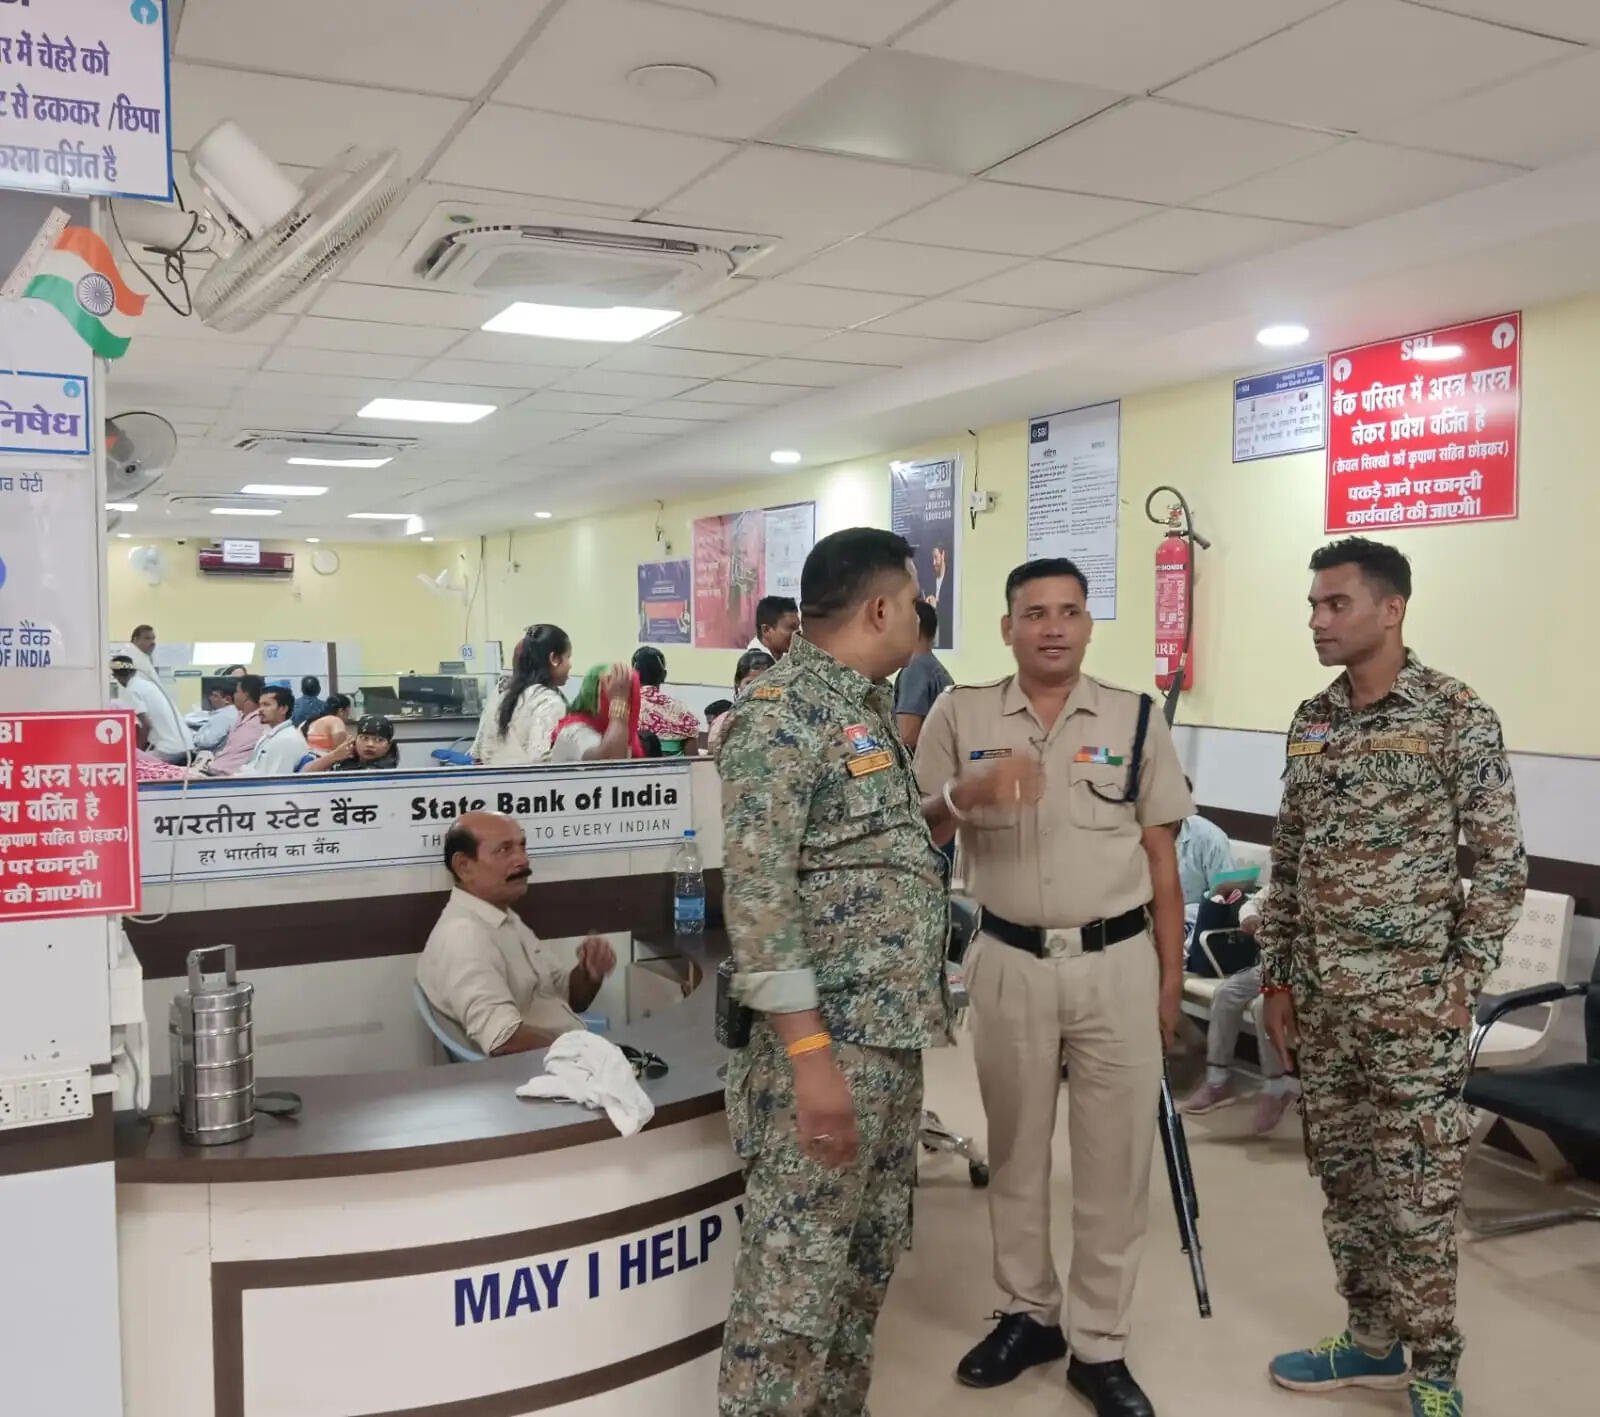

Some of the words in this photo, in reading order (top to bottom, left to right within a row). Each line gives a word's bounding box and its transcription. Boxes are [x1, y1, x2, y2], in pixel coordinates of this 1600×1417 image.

[0, 37, 12, 64] र
[16, 30, 32, 66] में
[37, 32, 76, 72] चेहरे
[81, 40, 110, 76] को
[11, 83, 28, 119] से
[32, 95, 100, 127] ढककर
[44, 138, 100, 179] वर्जित
[103, 145, 117, 182] है
[1361, 381, 1406, 412] परिसर
[1410, 375, 1424, 404] में
[1428, 373, 1466, 400] अस्त्र
[1351, 419, 1386, 446] लेकर
[1390, 415, 1424, 440] प्रवेश
[1430, 406, 1468, 435] वर्जित
[1439, 444, 1464, 461] सहित
[20, 472, 43, 492] पेटी
[935, 463, 950, 481] SBI
[1384, 477, 1410, 497] जाने
[1413, 479, 1431, 495] पर
[1434, 469, 1483, 496] कानूनी
[1406, 501, 1429, 520] की
[19, 619, 51, 646] बैंक
[16, 650, 51, 668] INDIA
[0, 721, 23, 743] BI
[20, 764, 72, 788] अस्त्र
[77, 763, 127, 787] शस्त्र
[25, 792, 78, 822] वर्जित
[85, 791, 100, 820] है
[411, 796, 487, 821] State
[497, 788, 565, 815] Bank
[575, 785, 603, 809] of
[612, 782, 678, 808] India
[153, 804, 256, 836] भारतीय
[266, 801, 320, 830] स्टेट
[330, 797, 378, 826] बैंक
[39, 827, 75, 847] सहित
[420, 834, 442, 848] TH
[535, 826, 555, 840] TO
[562, 821, 612, 838] EVERY
[619, 818, 671, 834] INDIAN
[8, 859, 34, 875] पर
[36, 850, 99, 875] कानूनी
[198, 849, 216, 866] हर
[224, 842, 279, 861] भारतीय
[286, 844, 306, 857] का
[313, 836, 340, 855] बैंक
[4, 883, 33, 904] की
[454, 1258, 569, 1327] MAY
[588, 1251, 599, 1299] I
[620, 1214, 722, 1291] HELP
